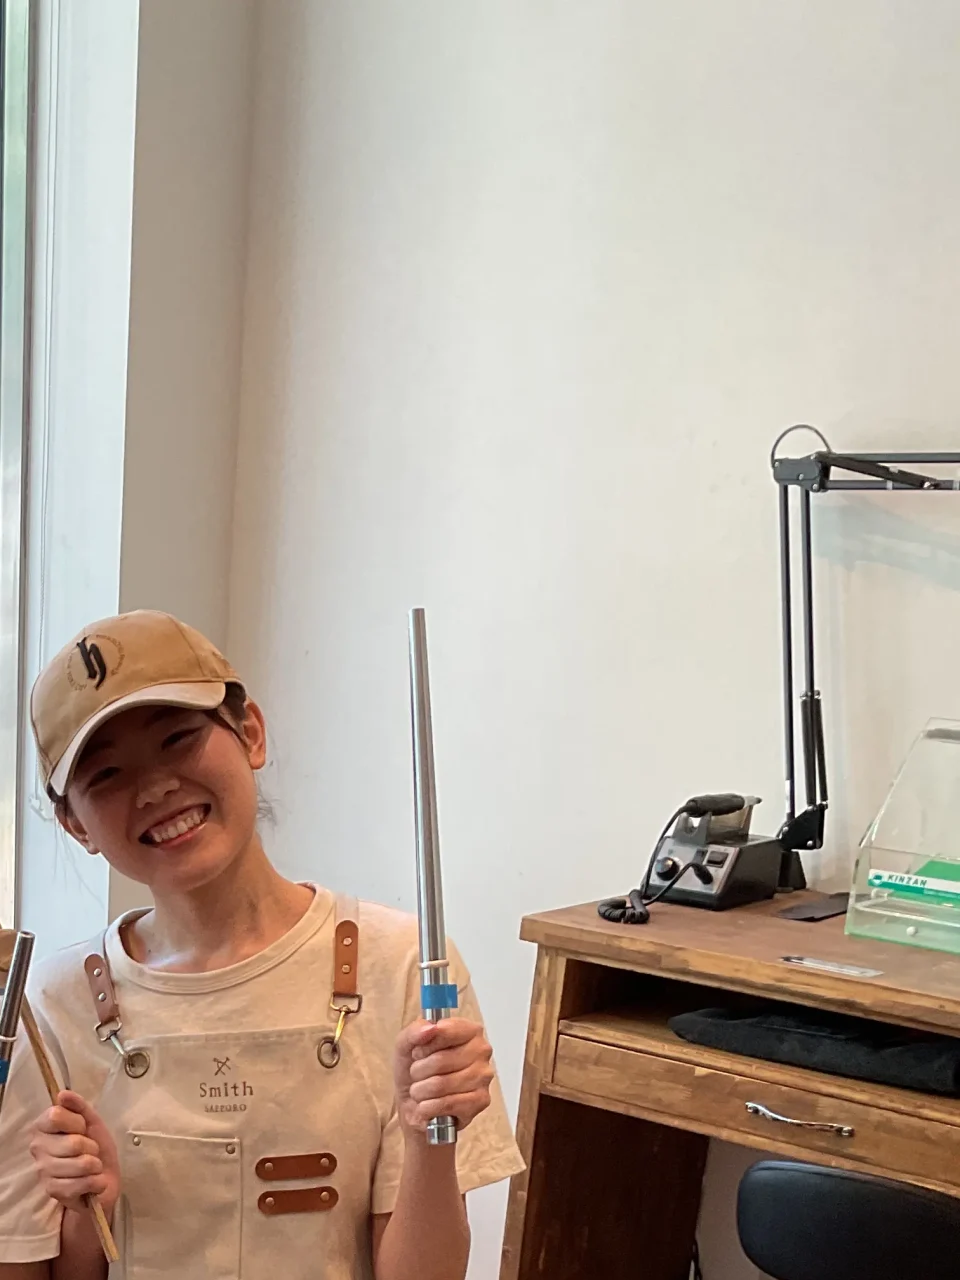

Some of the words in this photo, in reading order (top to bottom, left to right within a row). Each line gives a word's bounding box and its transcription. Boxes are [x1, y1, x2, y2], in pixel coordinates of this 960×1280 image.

[887, 874, 928, 887] KINZAN
[199, 1080, 254, 1098] Smith
[204, 1103, 247, 1113] SAPPORO
